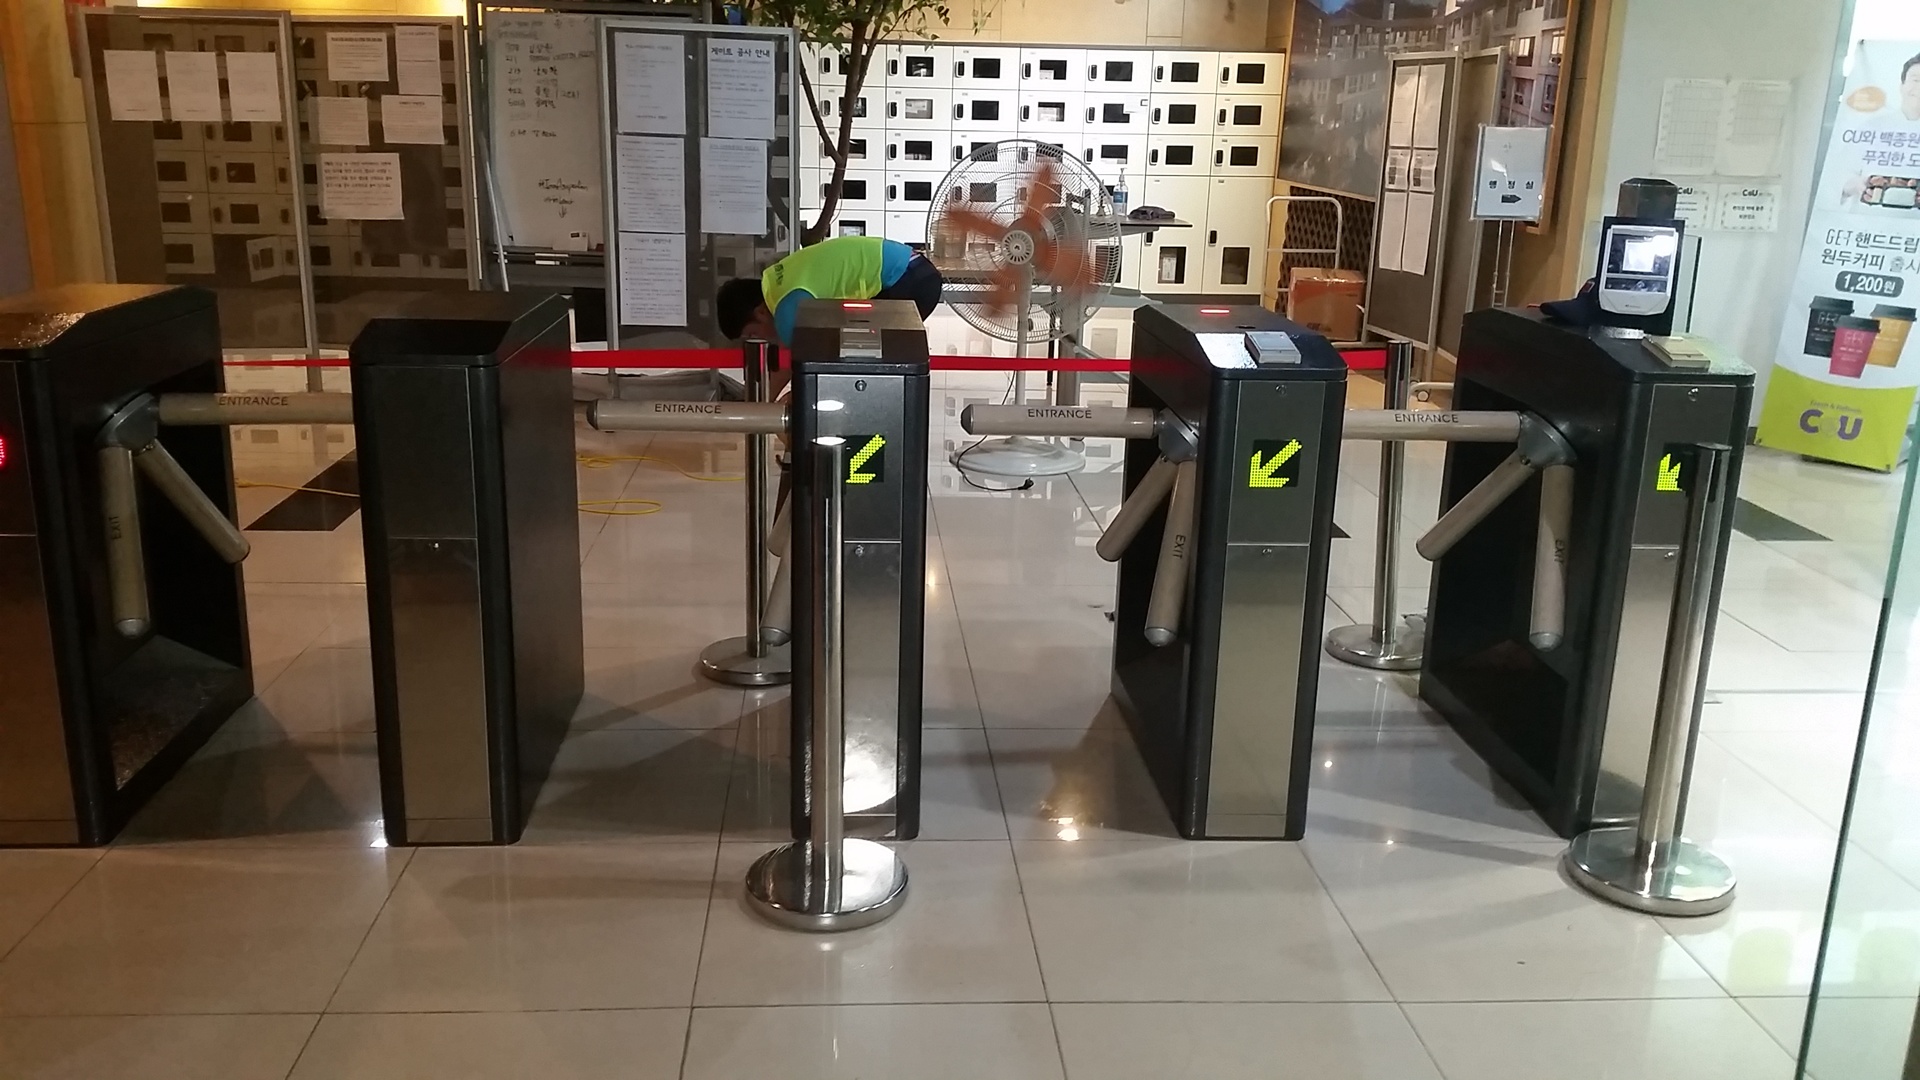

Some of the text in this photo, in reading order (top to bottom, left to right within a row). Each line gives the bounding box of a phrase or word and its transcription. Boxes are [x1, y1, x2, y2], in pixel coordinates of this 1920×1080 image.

[711, 47, 770, 58] 게이트 공사 안내
[1842, 129, 1920, 148] CU와 백종원
[1862, 150, 1905, 167] 푸짐한
[1825, 228, 1920, 254] GET 핸드드립
[1821, 248, 1885, 271] 원두커피
[1844, 273, 1896, 294] 1,200원
[219, 396, 289, 406] ENTRANCE
[654, 403, 722, 414] ENTRANCE
[1028, 408, 1092, 419] ENTRANCE
[1395, 413, 1459, 424] ENTRANCE
[109, 516, 122, 540] EXIT
[1173, 534, 1186, 559] EXIT
